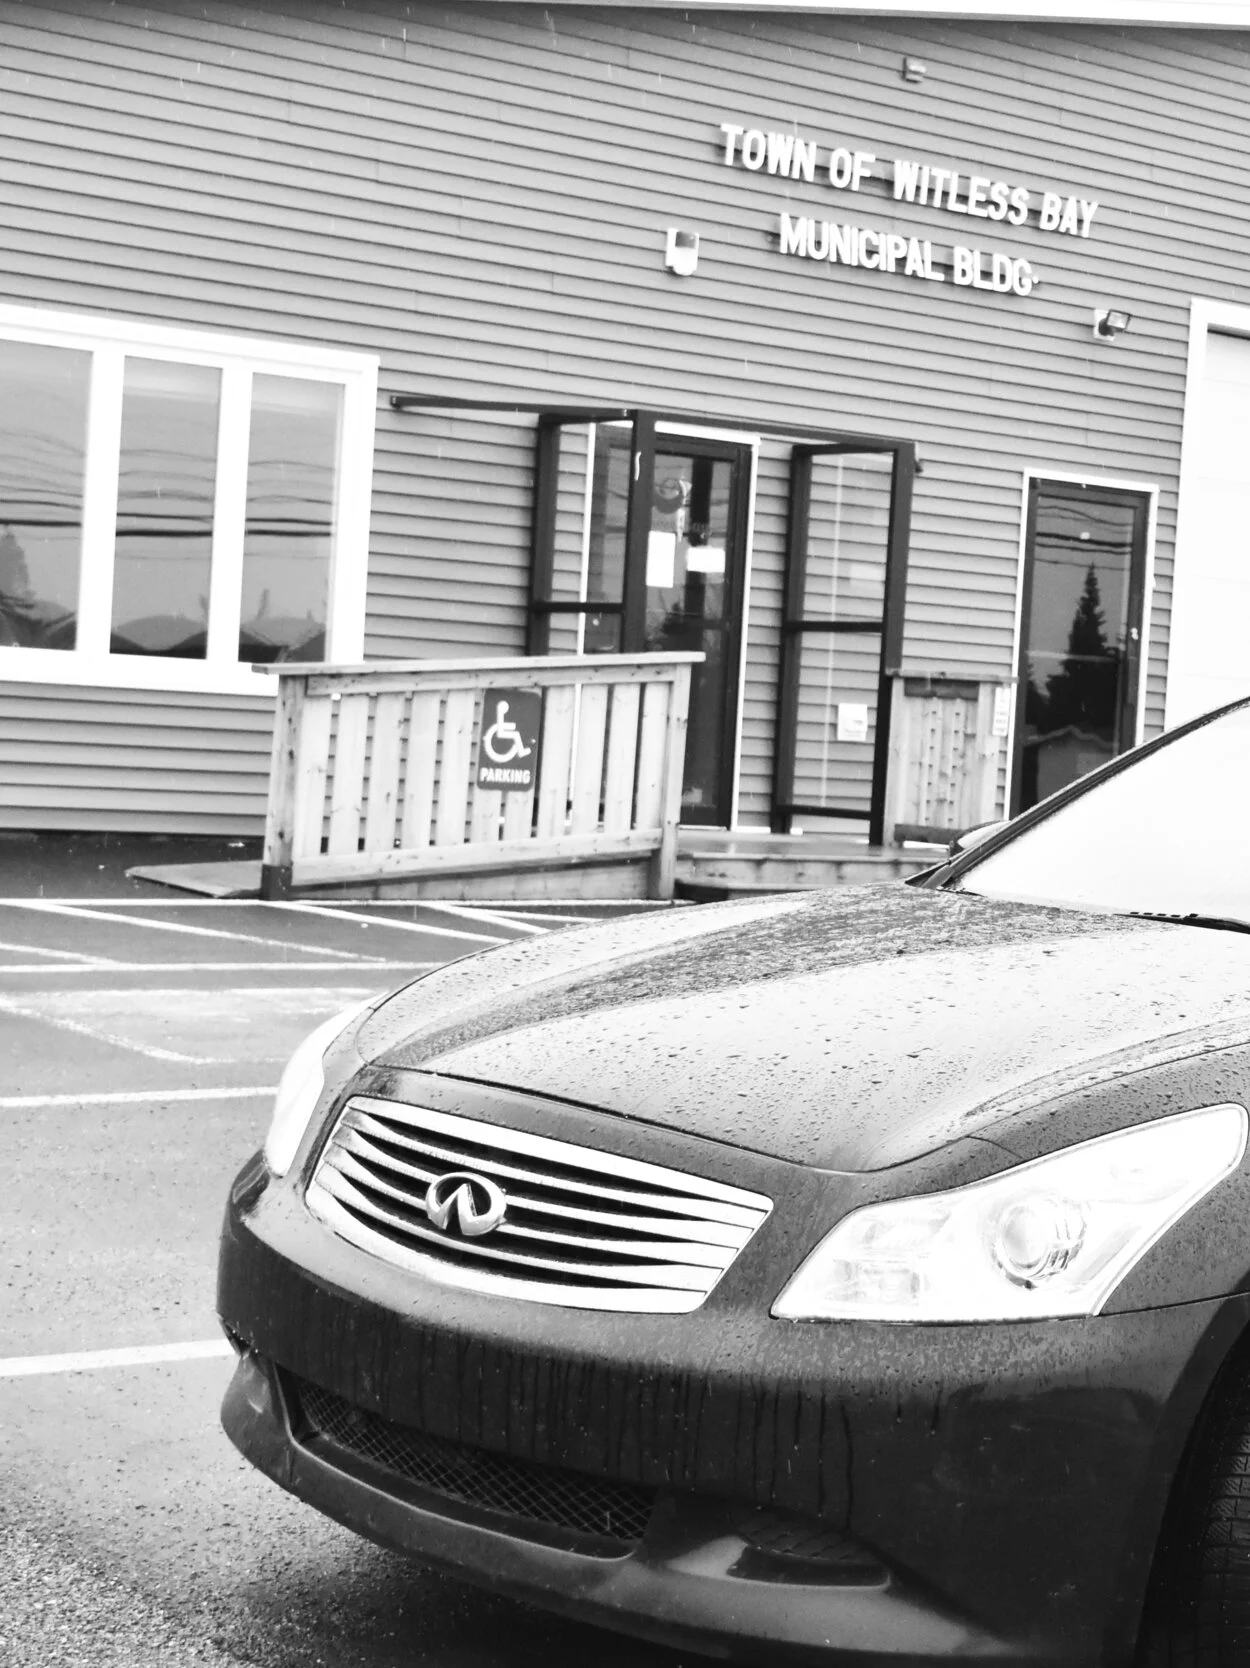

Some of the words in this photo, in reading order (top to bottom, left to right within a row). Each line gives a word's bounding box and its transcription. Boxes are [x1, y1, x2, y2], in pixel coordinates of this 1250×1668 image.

[720, 123, 817, 182] TOWN
[829, 148, 876, 191] OF
[893, 159, 1030, 225] WITLESS
[1039, 192, 1098, 238] BAY
[779, 212, 944, 281] MUNICIPAL
[480, 767, 531, 784] PARKING
